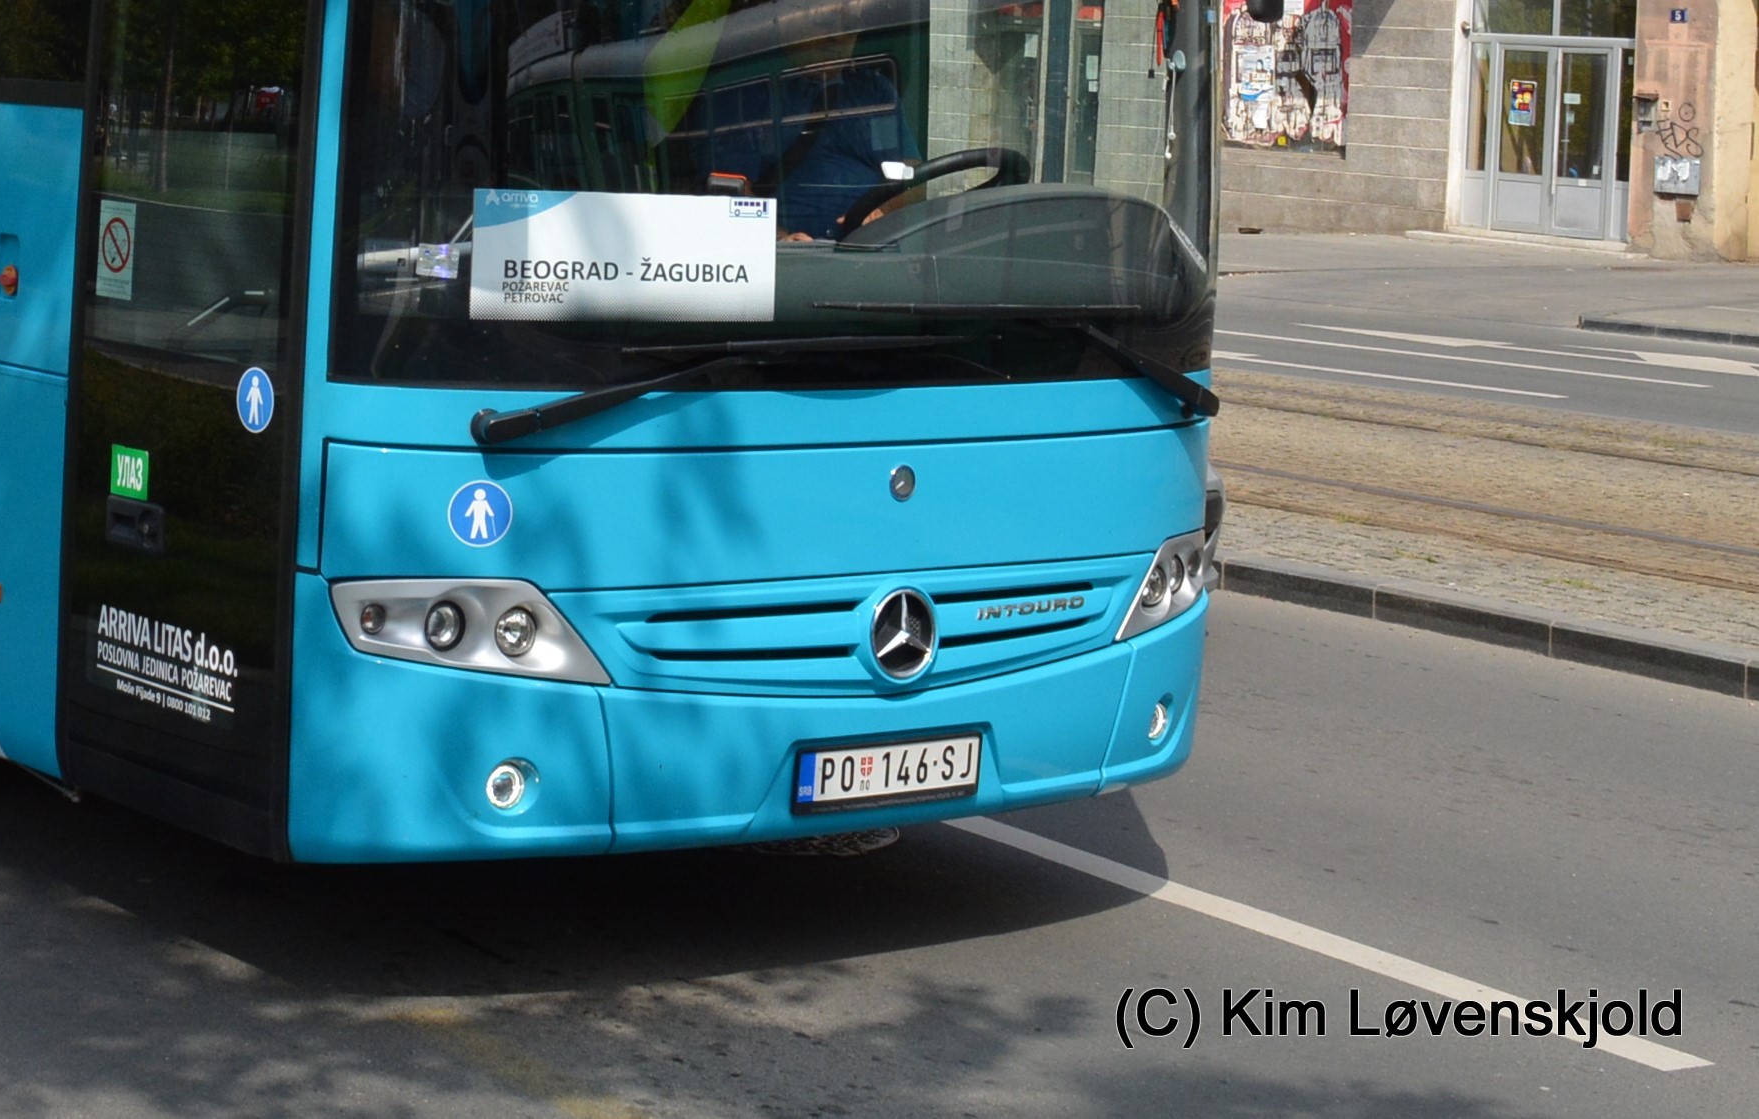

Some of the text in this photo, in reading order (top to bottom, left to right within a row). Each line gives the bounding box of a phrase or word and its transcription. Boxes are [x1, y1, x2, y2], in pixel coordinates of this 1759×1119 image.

[501, 192, 539, 203] arriva
[503, 259, 619, 281] BEOGRAD
[639, 257, 749, 283] ŽAGUBICA
[501, 280, 570, 292] POŽAREVAC
[503, 291, 564, 304] PETROVAC
[116, 453, 144, 492] УЛАЗ
[976, 595, 1085, 621] INTOURO
[97, 604, 238, 678] ARRIVA LITAS d.o.o.
[97, 640, 232, 702] POSLOVNA JEDINICA POŽAREVAC
[798, 785, 813, 798] SRB
[820, 755, 855, 796] PO
